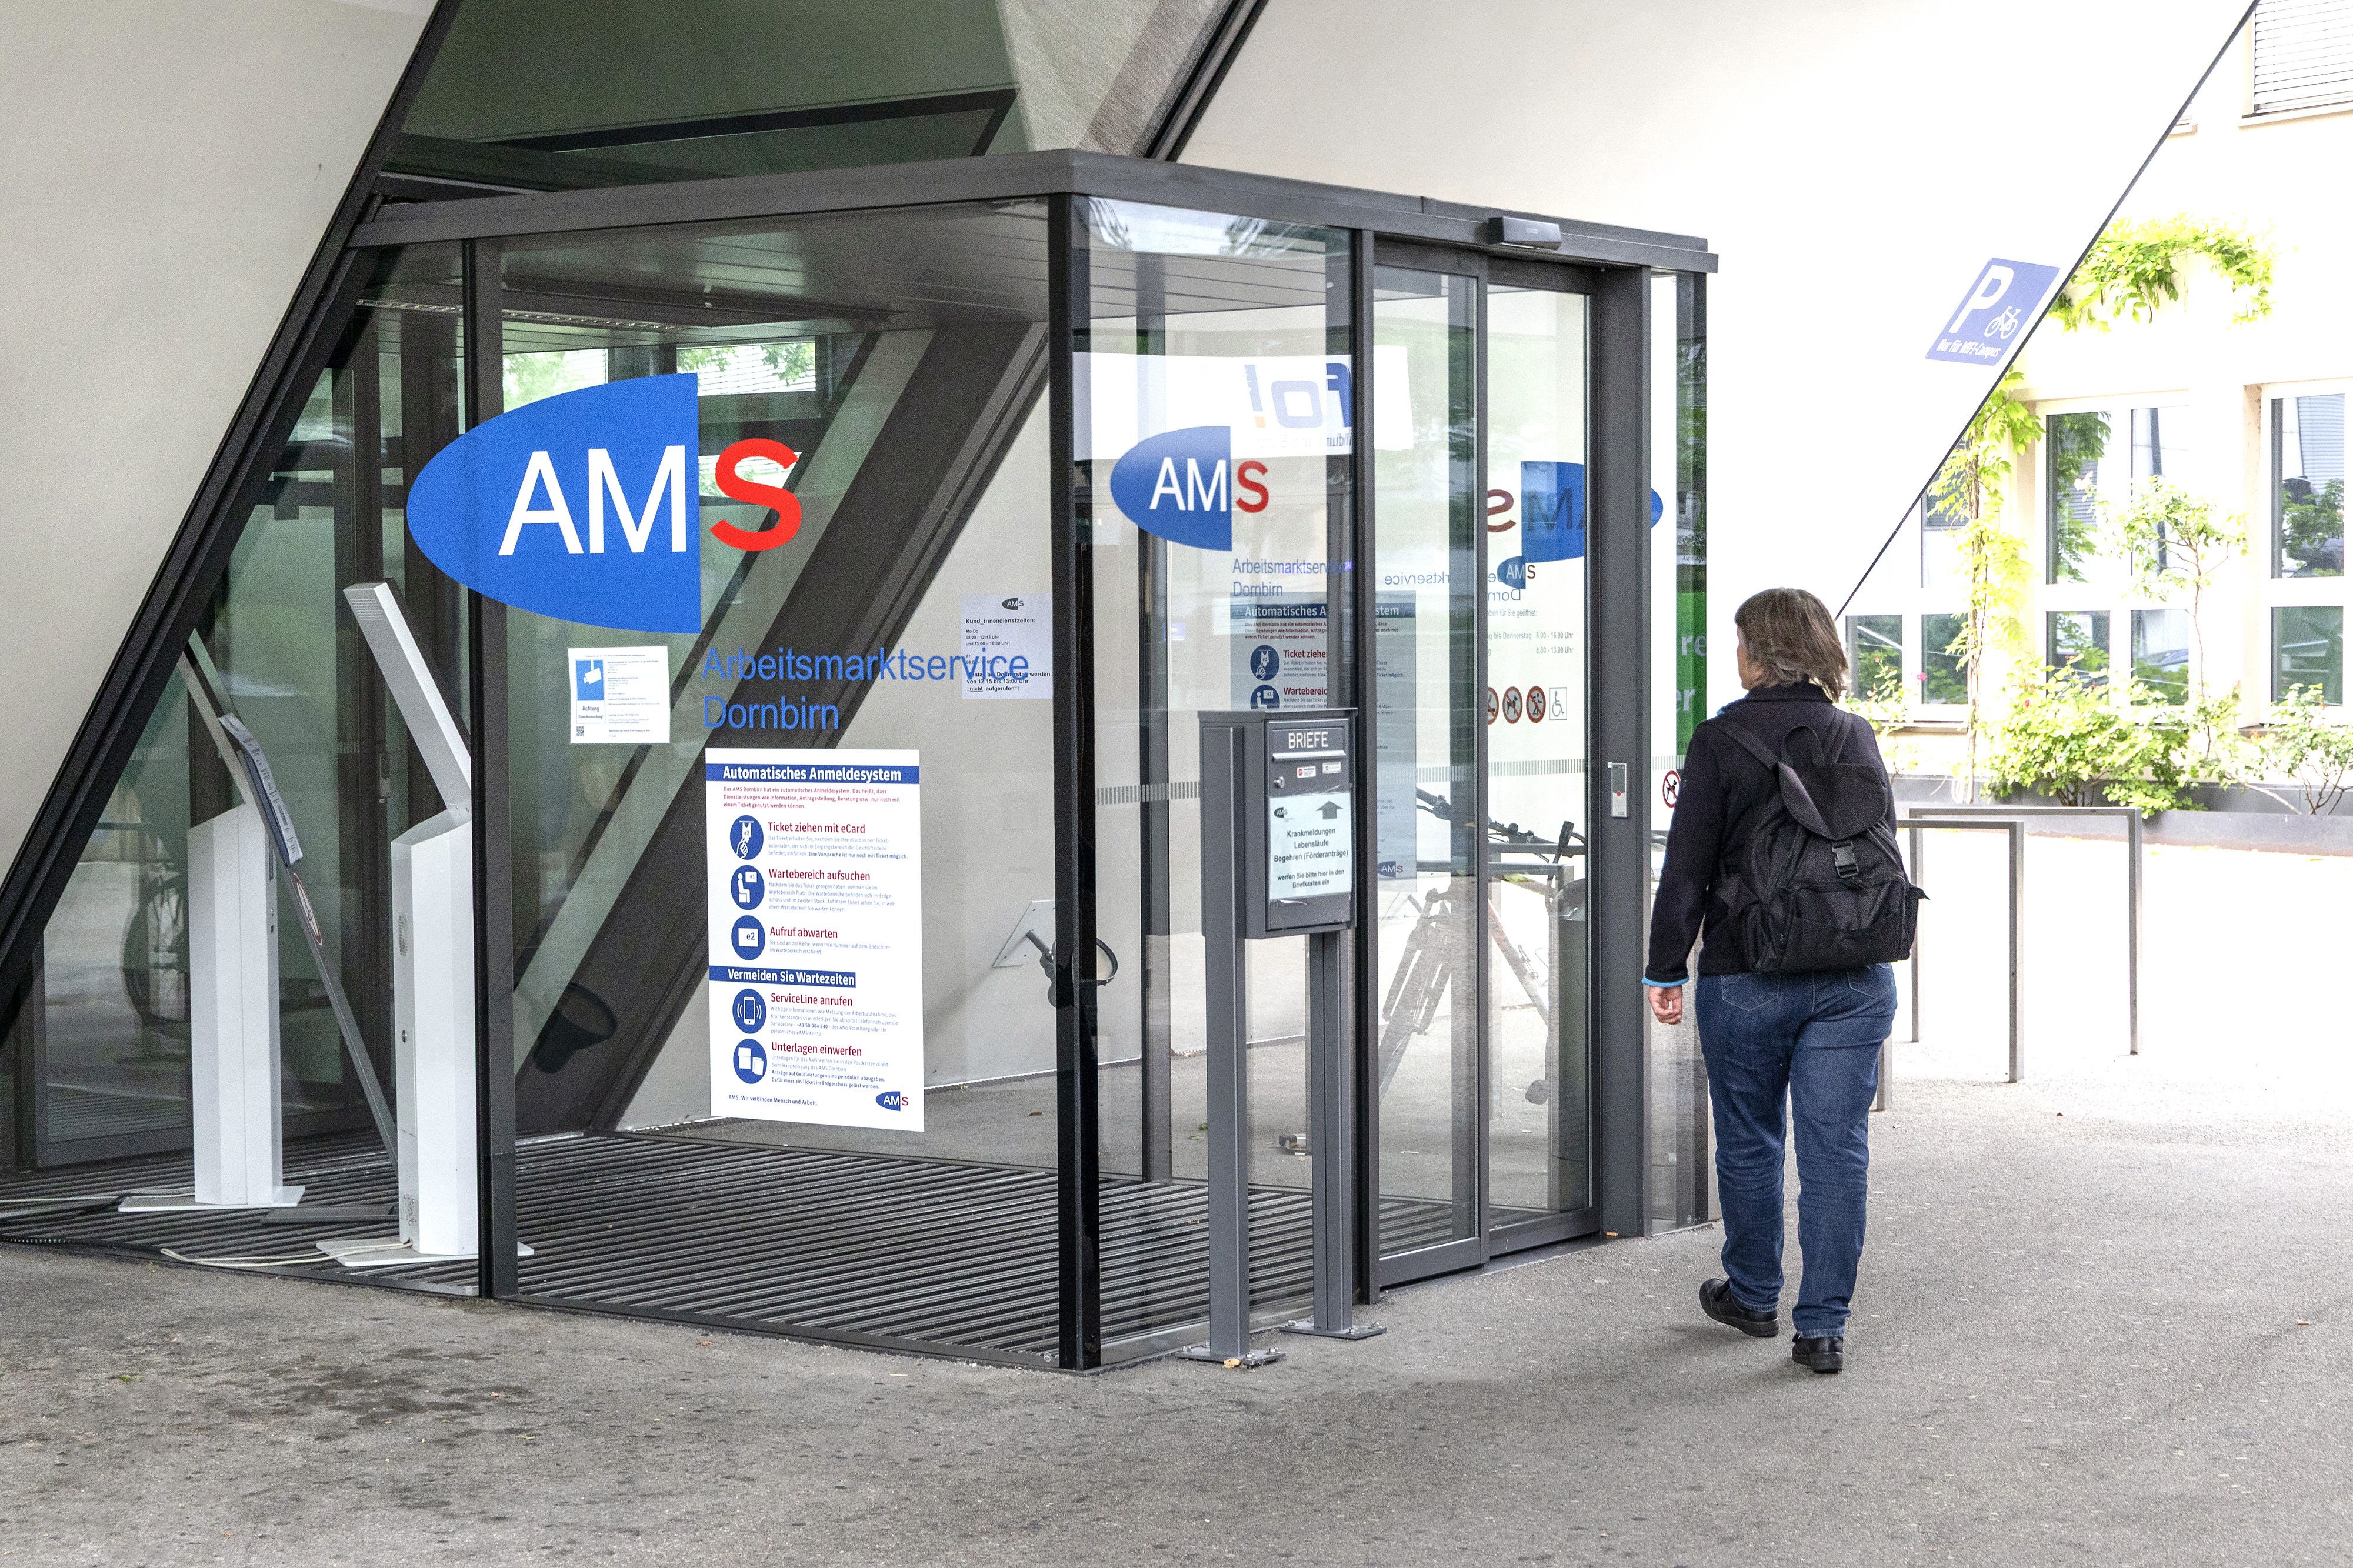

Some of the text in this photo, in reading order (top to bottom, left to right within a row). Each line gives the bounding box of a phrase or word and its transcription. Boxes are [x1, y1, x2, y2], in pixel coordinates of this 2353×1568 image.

[1948, 265, 2014, 333] P
[1936, 338, 1951, 352] Nur
[1150, 456, 1269, 513] AMS
[498, 438, 802, 555] AMS
[1505, 564, 1536, 579] AMS
[1233, 581, 1283, 597] Dornbirn
[1244, 606, 1318, 618] Automatisches
[701, 647, 1029, 680] Arbeitsmarktservice
[1283, 686, 1328, 696] Wartebereic
[704, 696, 839, 729] Dornbirn
[1288, 731, 1329, 749] BRIEFE
[722, 766, 902, 783] Automatisches Anmeldesystem
[768, 821, 865, 833] Ticket ziehen mit eCard
[1287, 828, 1336, 838] Krankmeldungen
[1294, 839, 1329, 849] Lebensläufe
[1274, 849, 1348, 863] Begehren (Förderanträge)
[768, 868, 871, 881] Wartebereich aufsuchen
[1381, 865, 1404, 873] AMS
[1292, 880, 1321, 889] Briefkasten
[746, 932, 755, 940] e2
[769, 926, 838, 939] Aufruf abwarten
[727, 968, 855, 986] Vermeiden Sie Wartezeiten
[771, 992, 853, 1006] ServiceLine anrufen
[771, 1042, 862, 1056] Unterlagen einwerfen
[796, 1071, 828, 1079] Geldleistungen
[883, 1093, 909, 1106] AMS
